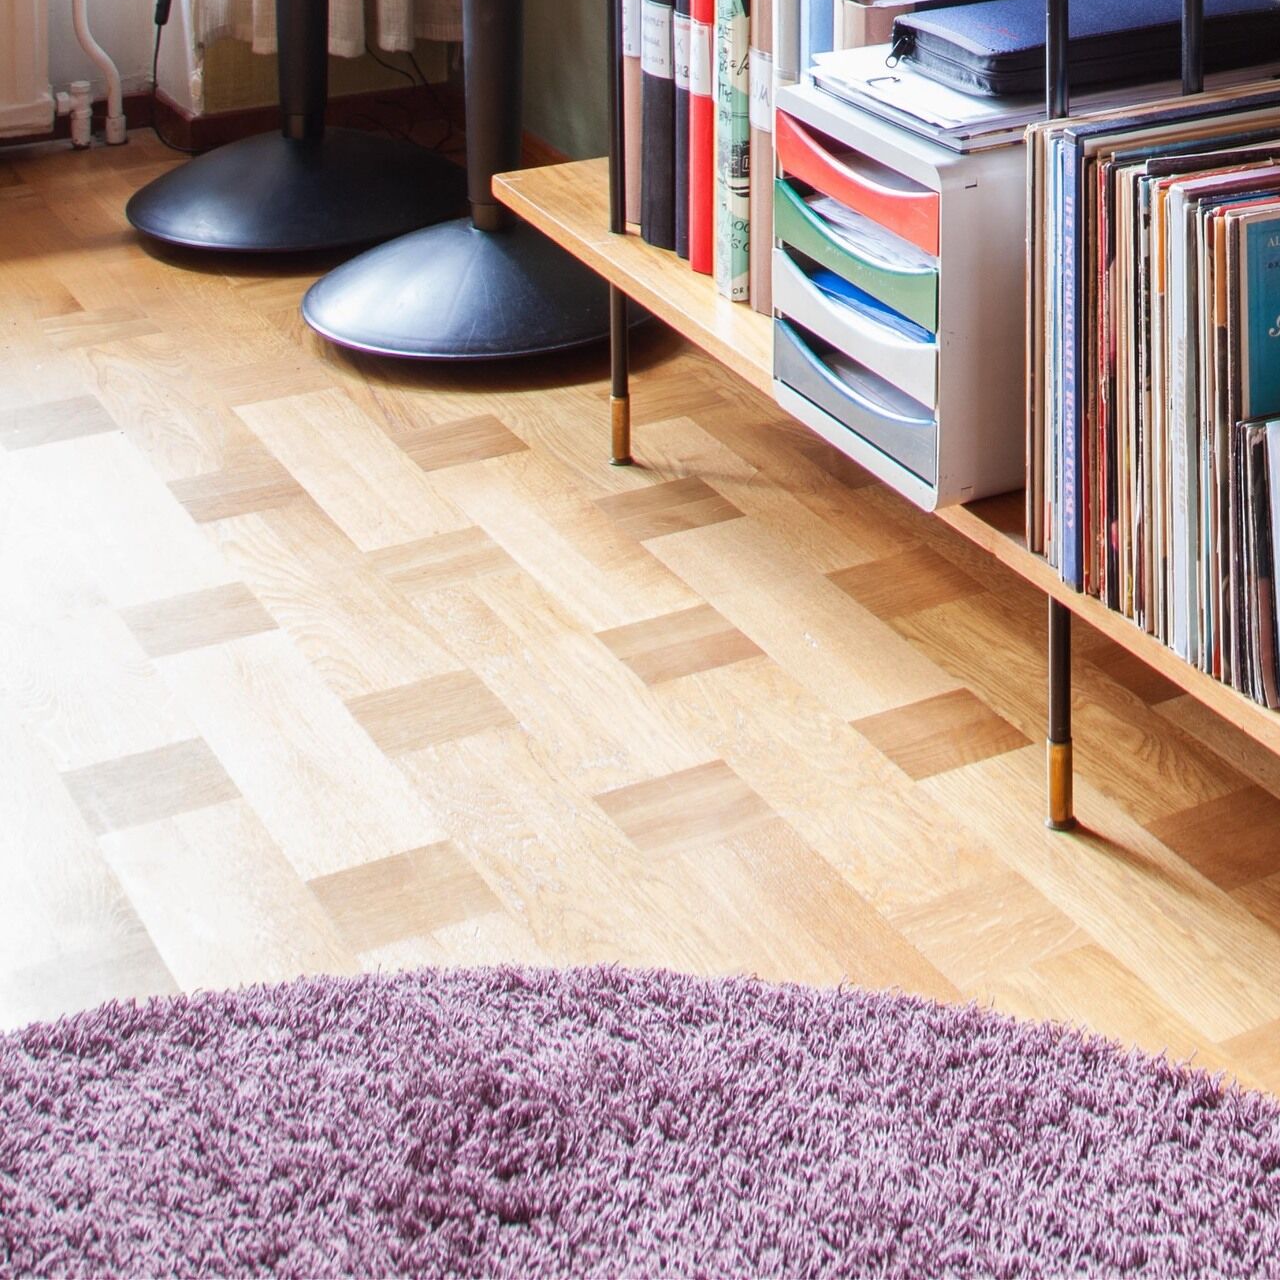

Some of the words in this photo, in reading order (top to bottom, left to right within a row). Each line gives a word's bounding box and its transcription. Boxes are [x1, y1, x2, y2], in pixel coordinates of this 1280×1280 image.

[1064, 195, 1075, 230] THE
[1064, 237, 1075, 381] INCOMPARABLE
[1064, 390, 1075, 450] TOMMY
[1064, 457, 1075, 529] DORSEY
